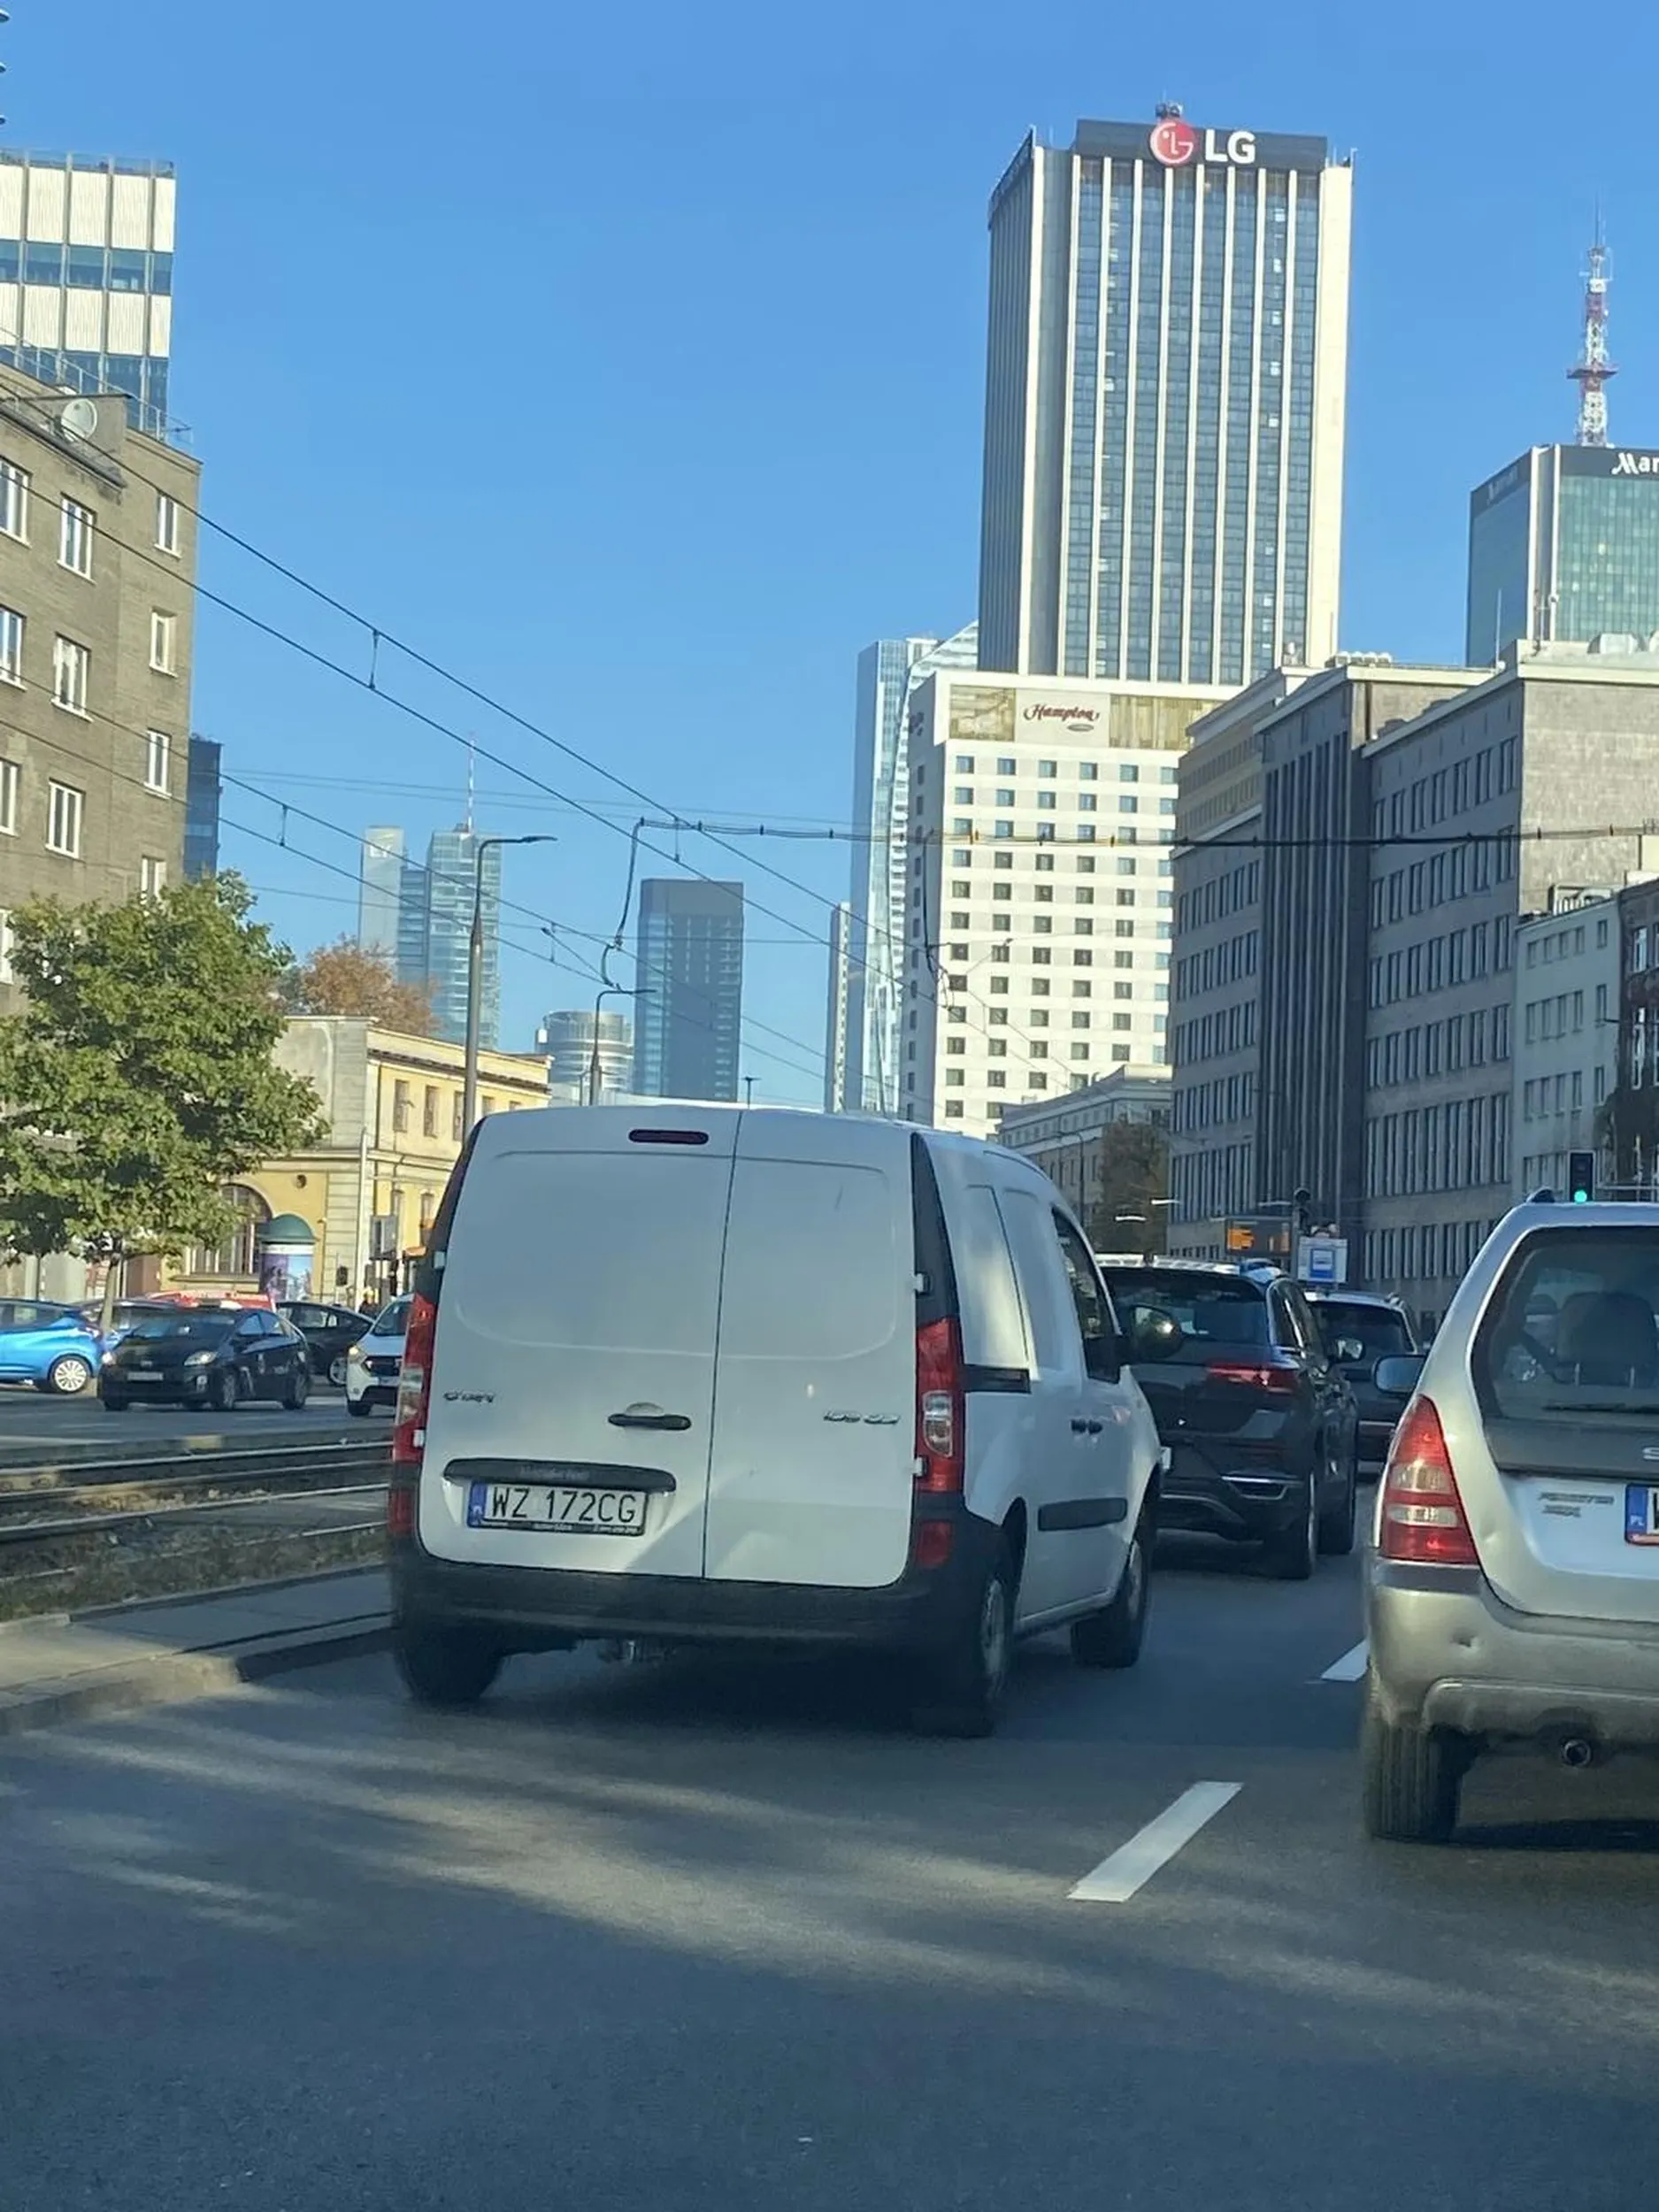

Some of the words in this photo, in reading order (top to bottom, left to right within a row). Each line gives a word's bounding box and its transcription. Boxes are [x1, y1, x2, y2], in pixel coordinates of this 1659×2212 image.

[1205, 129, 1256, 165] LG
[1024, 703, 1101, 722] Hampton
[493, 1486, 529, 1518] WZ
[546, 1490, 636, 1524] 172CG
